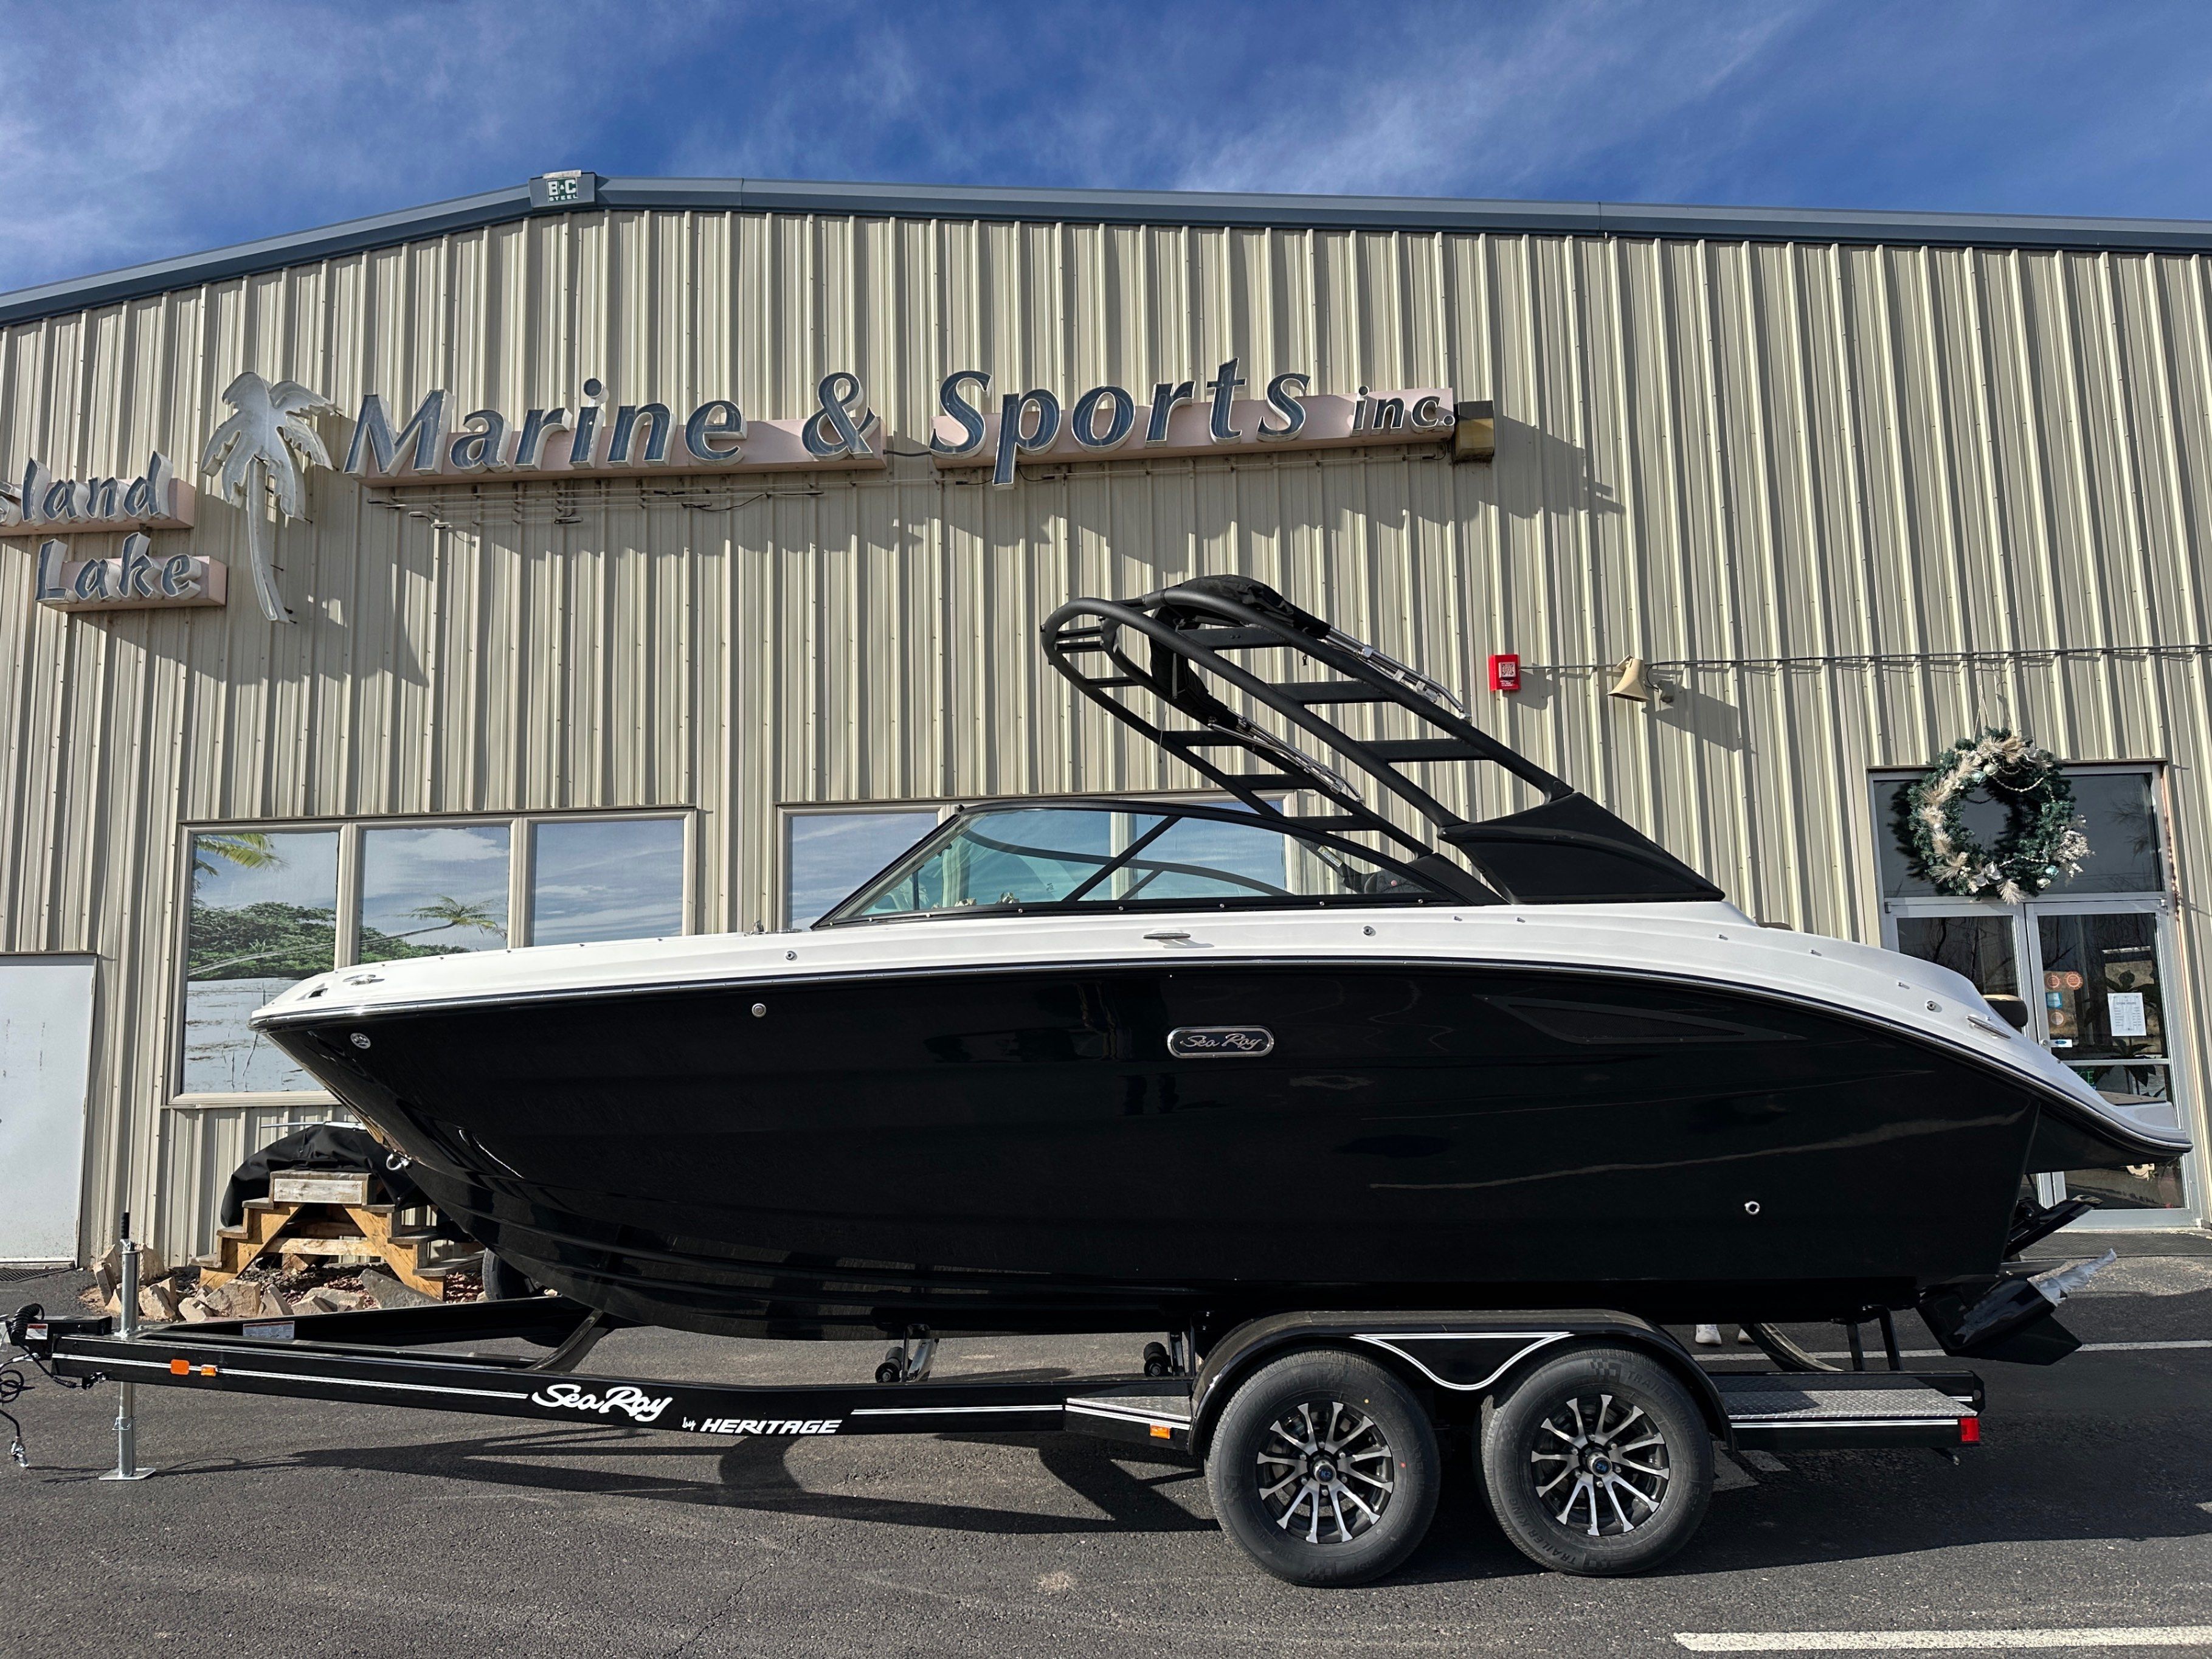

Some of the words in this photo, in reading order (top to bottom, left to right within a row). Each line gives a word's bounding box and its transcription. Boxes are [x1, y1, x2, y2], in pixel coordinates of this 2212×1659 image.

[344, 377, 747, 478] Marine
[801, 372, 880, 462] &
[929, 357, 1312, 489] Sports
[1350, 385, 1456, 437] inc.
[35, 532, 202, 604] Lake
[1180, 1035, 1220, 1047] Sea
[1222, 1033, 1262, 1050] Ray
[531, 1384, 604, 1410] Sea
[598, 1386, 673, 1422] Ray
[1627, 1370, 1674, 1406] TRAILER
[682, 1416, 696, 1432] by
[700, 1418, 842, 1434] HERITAGE
[1509, 1497, 1528, 1528] KING
[1527, 1528, 1577, 1566] TRAILER
